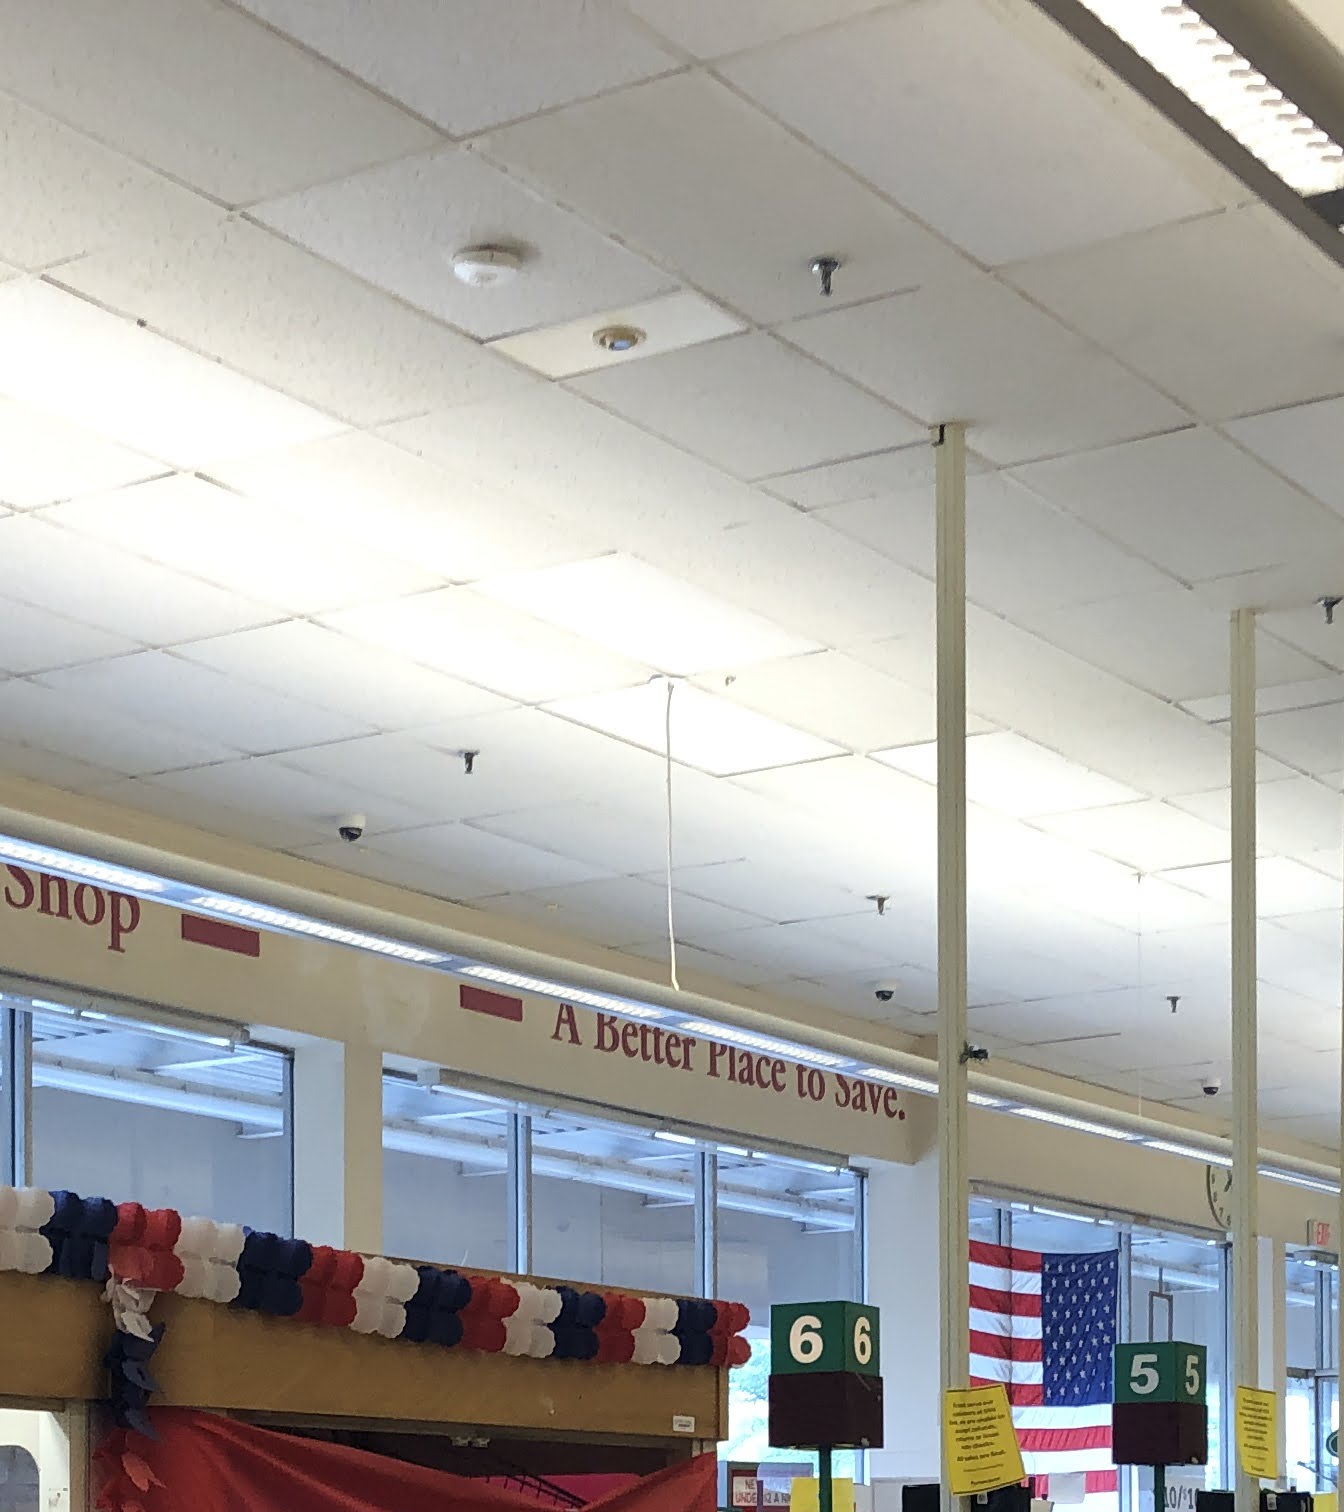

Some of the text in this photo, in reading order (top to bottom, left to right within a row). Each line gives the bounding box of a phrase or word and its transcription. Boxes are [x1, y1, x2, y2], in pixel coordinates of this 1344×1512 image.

[3, 864, 141, 953] Shop
[551, 1002, 582, 1046] A
[593, 1014, 695, 1073] Better
[707, 1040, 787, 1094] Place
[796, 1063, 825, 1102] to
[789, 1314, 824, 1364] 6
[853, 1316, 872, 1365] 6
[1129, 1353, 1160, 1395] 5
[1184, 1354, 1200, 1396] 5
[735, 1491, 757, 1503] UNDE
[745, 1478, 757, 1490] NE
